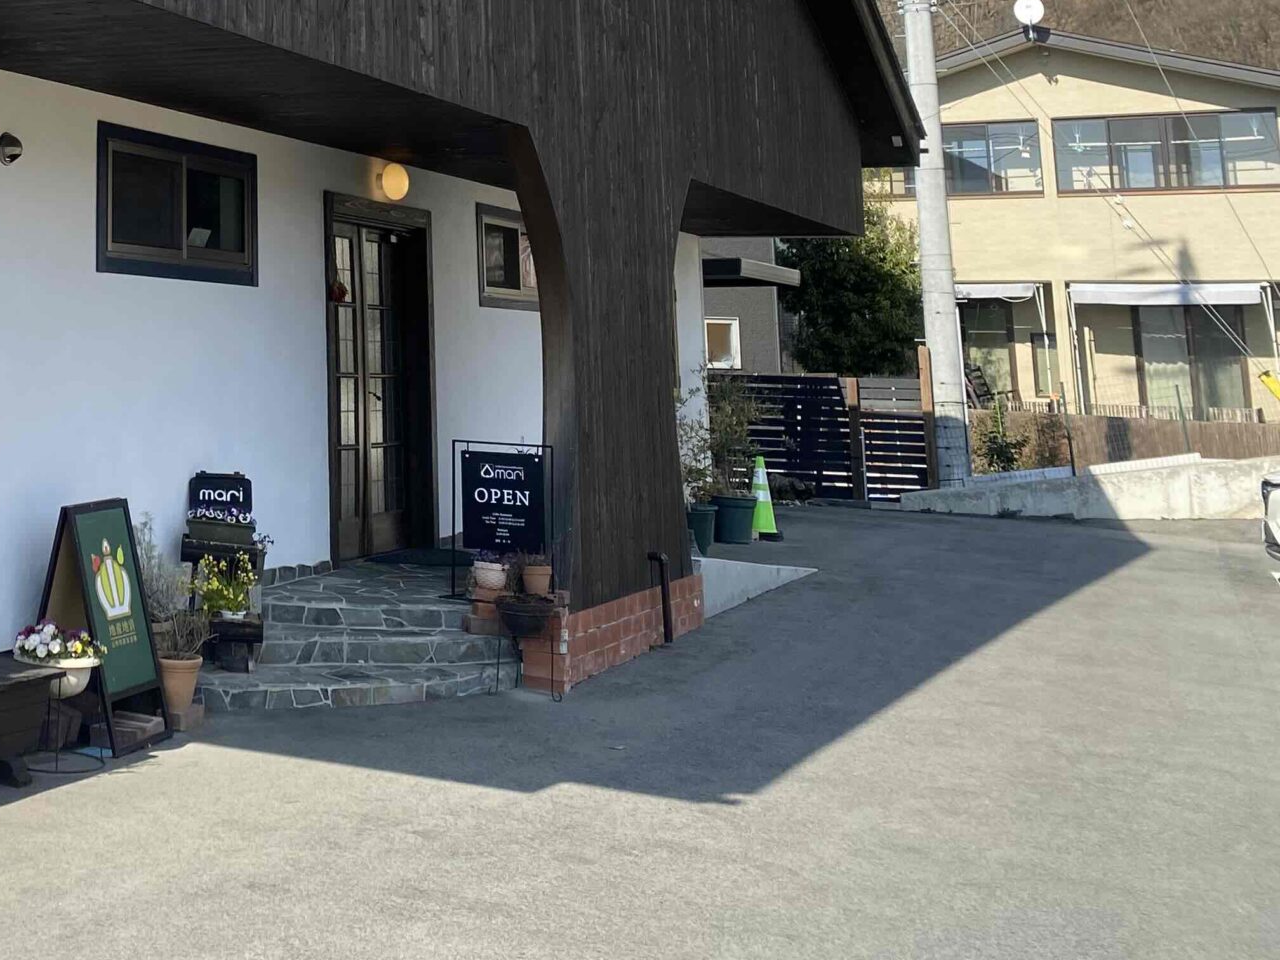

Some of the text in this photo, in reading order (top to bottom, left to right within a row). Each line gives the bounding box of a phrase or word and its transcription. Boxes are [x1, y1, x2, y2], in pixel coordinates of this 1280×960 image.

[495, 469, 524, 480] mari
[199, 487, 243, 502] mari
[474, 487, 530, 506] OPEN
